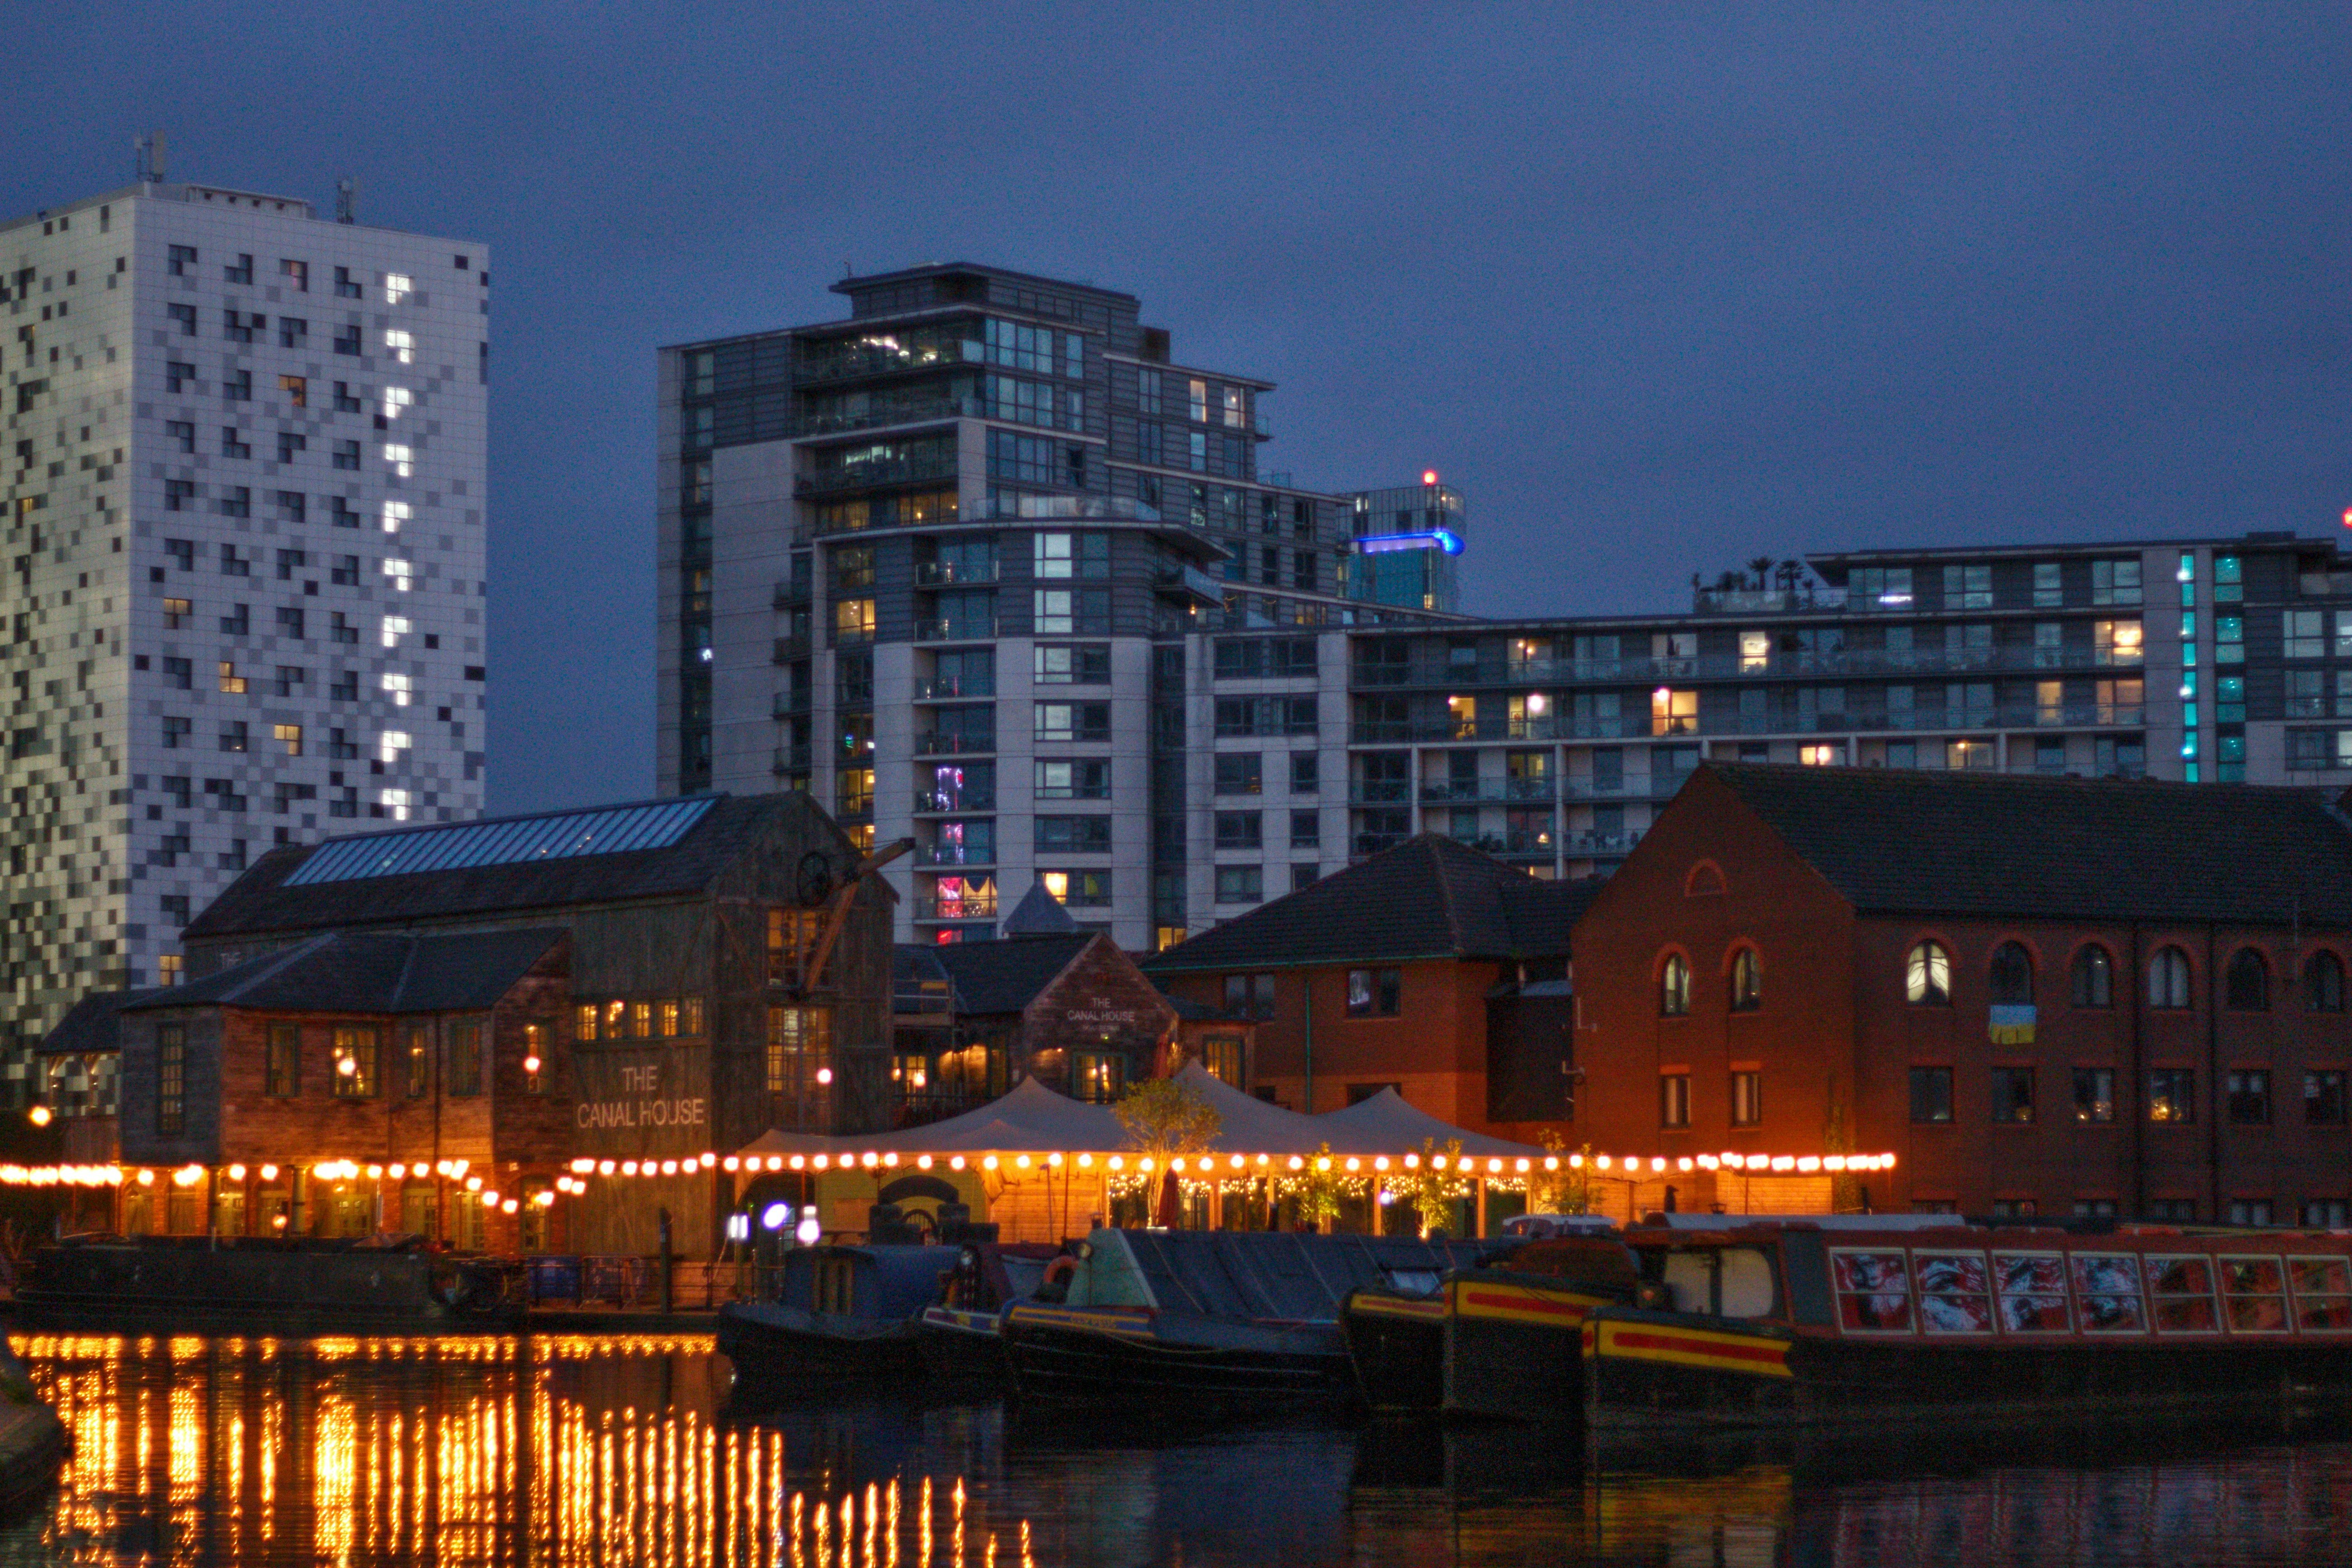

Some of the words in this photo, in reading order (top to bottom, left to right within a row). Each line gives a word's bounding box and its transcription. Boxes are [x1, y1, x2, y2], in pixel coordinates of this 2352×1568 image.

[1092, 998, 1111, 1009] THE
[1067, 1009, 1100, 1021] CANAL
[1101, 1010, 1135, 1022] HOUSE
[622, 1065, 658, 1092] THE
[577, 1101, 635, 1128] CANAL
[640, 1098, 704, 1126] HOUSE
